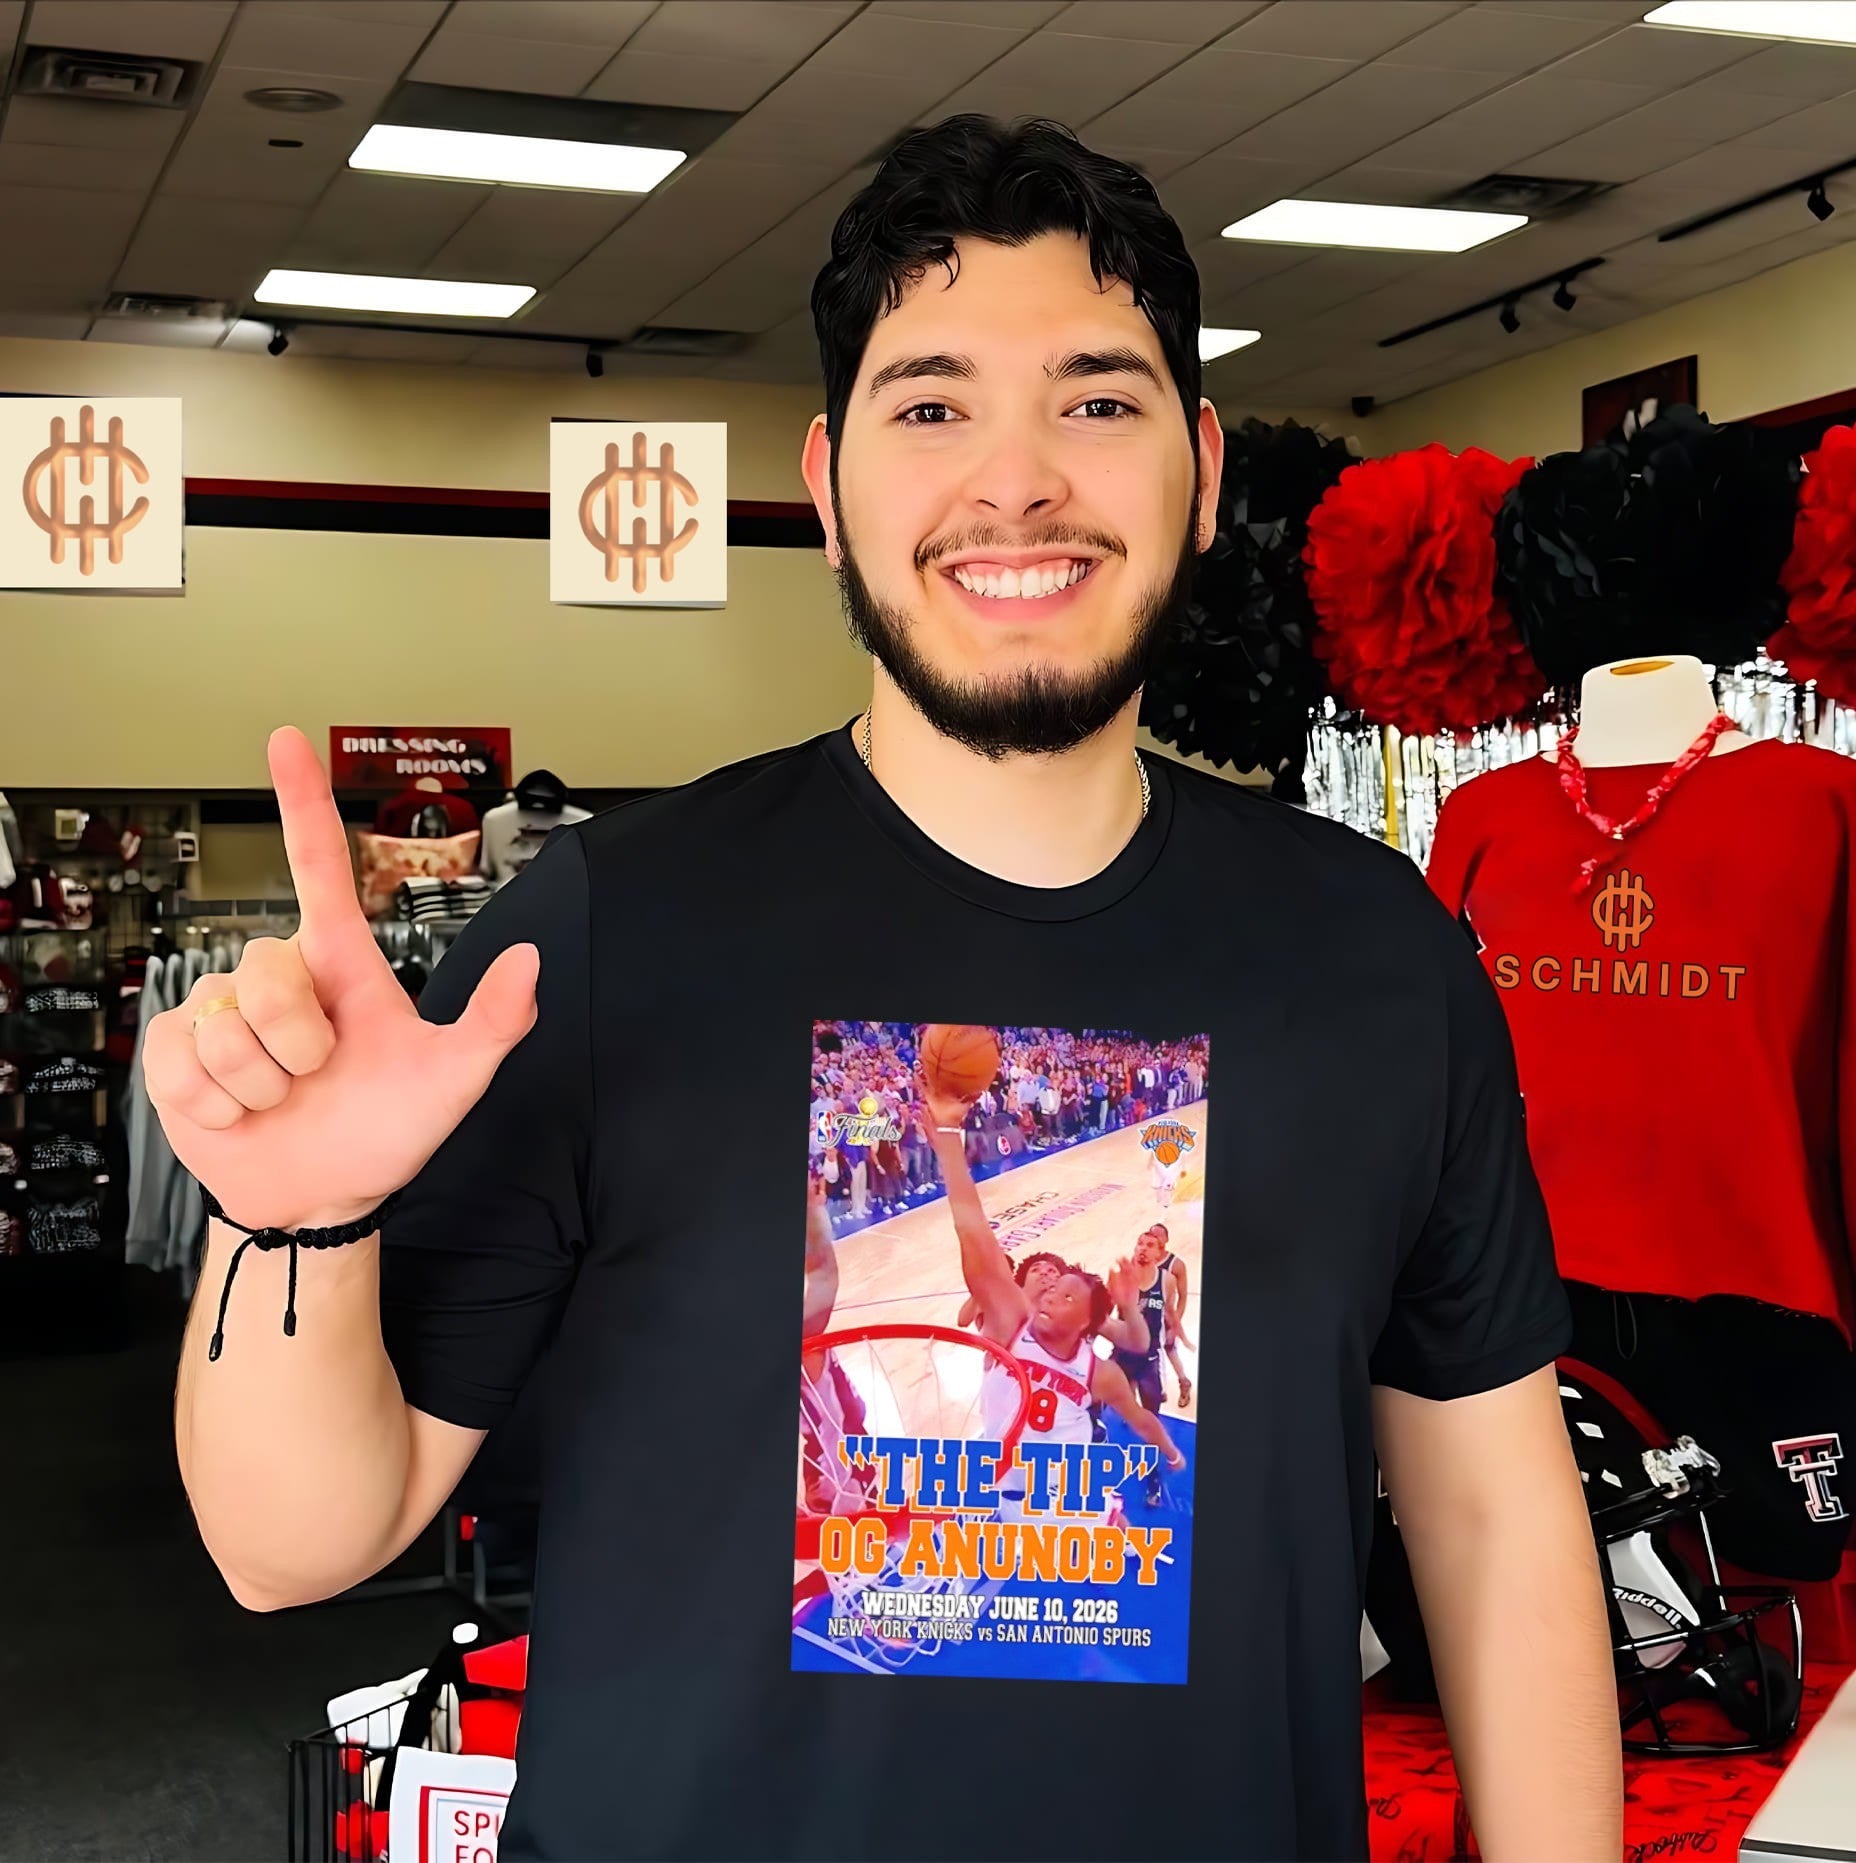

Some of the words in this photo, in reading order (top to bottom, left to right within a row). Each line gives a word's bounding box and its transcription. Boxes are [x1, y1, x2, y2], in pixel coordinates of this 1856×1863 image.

[1494, 953, 1746, 1000] SCHMIDT
[1029, 1388, 1058, 1433] 8
[820, 1516, 888, 1576] OG
[899, 1518, 1173, 1585] ANUNOBY
[862, 1591, 985, 1619] WEDNESDAY
[989, 1596, 1039, 1621] JUNE
[1043, 1598, 1069, 1625] 10,
[1072, 1598, 1119, 1623] 2026
[828, 1617, 865, 1637] NEW
[870, 1619, 913, 1639] YORK
[916, 1620, 973, 1640] KNICKS
[996, 1624, 1028, 1642] SAN
[1032, 1625, 1099, 1645] ANTONIO
[1102, 1627, 1152, 1647] SPURS
